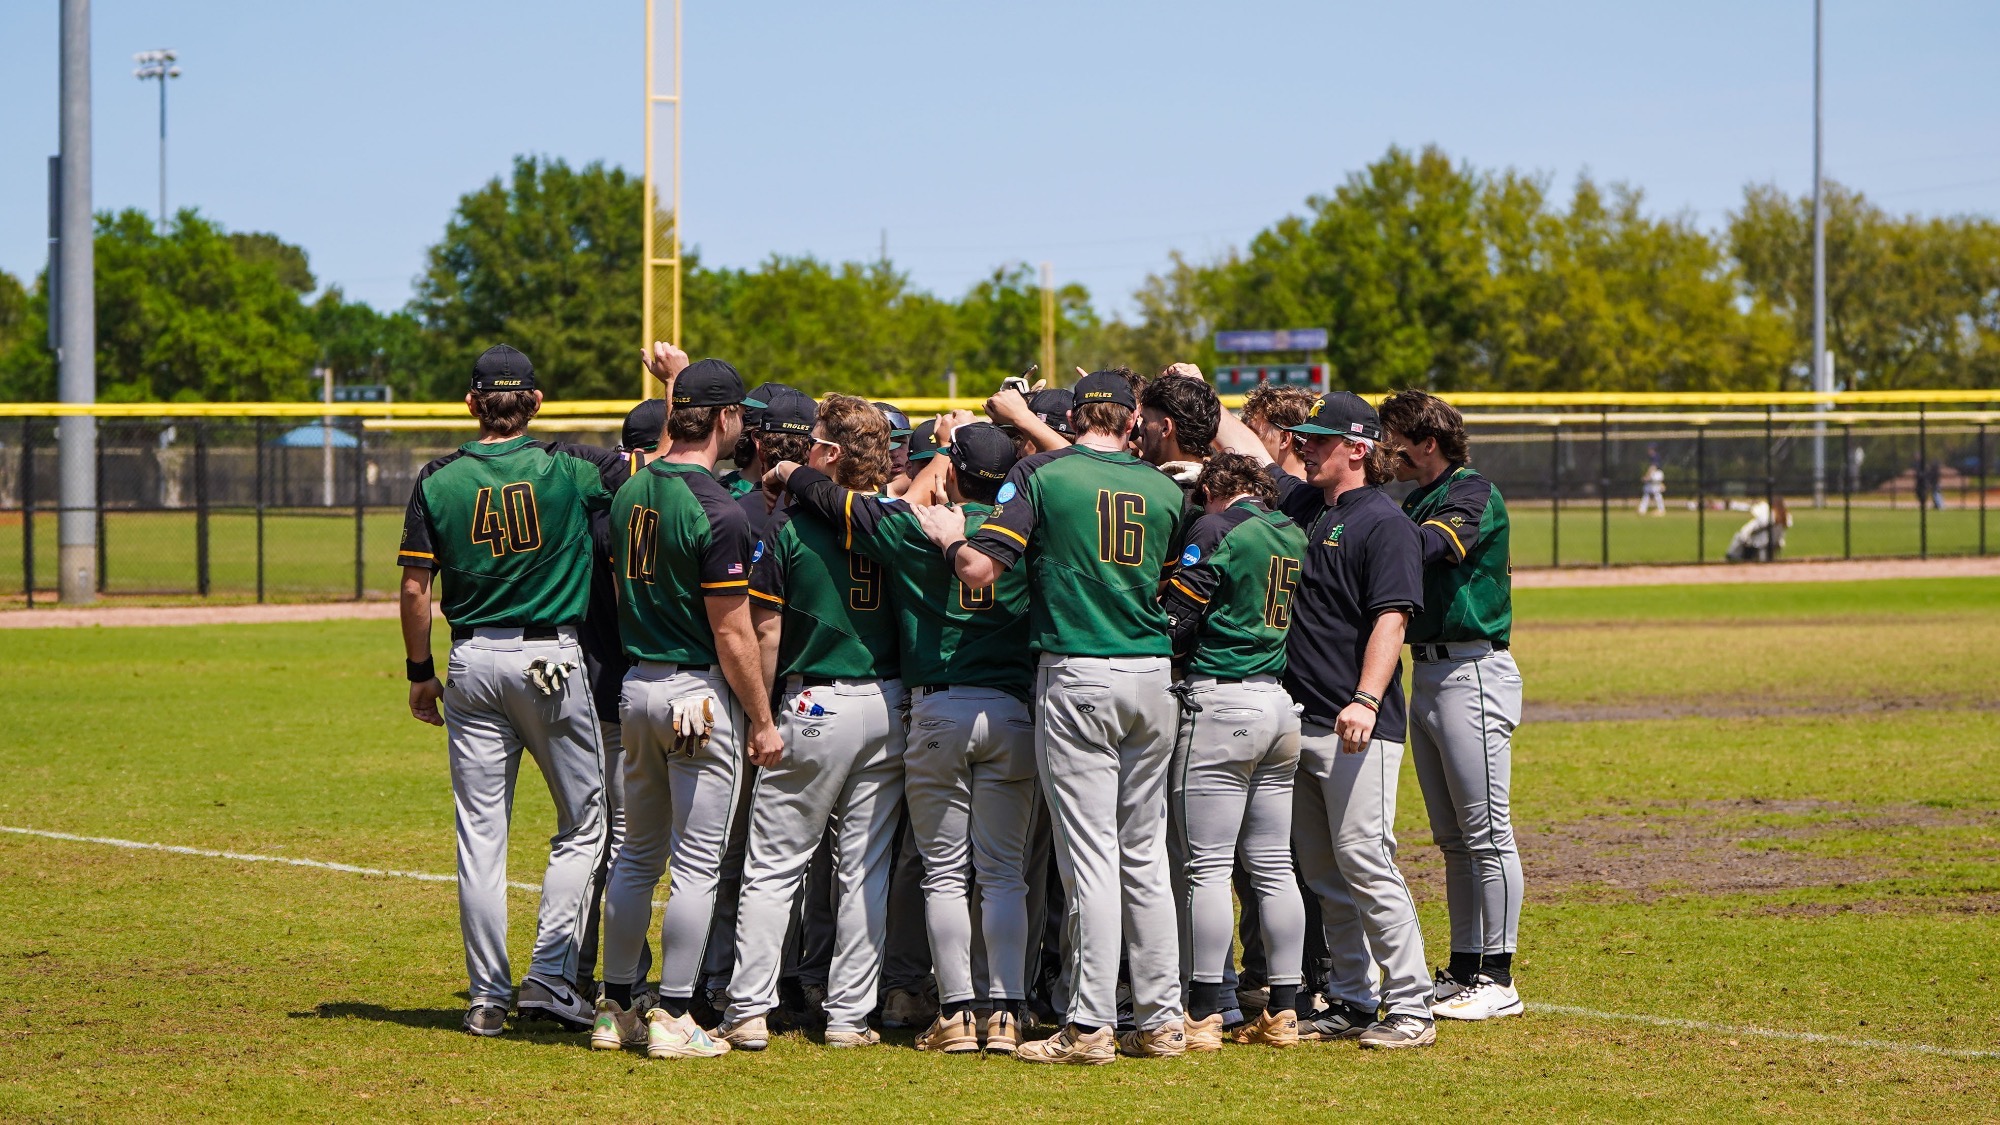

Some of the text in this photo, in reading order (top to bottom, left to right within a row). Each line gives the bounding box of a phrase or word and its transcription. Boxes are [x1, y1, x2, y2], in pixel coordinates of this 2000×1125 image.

[782, 422, 810, 430] EAGLES
[472, 482, 542, 557] 40
[627, 504, 660, 585] 10
[1096, 489, 1145, 566] 16
[850, 551, 881, 610] 9
[1264, 555, 1300, 629] 15
